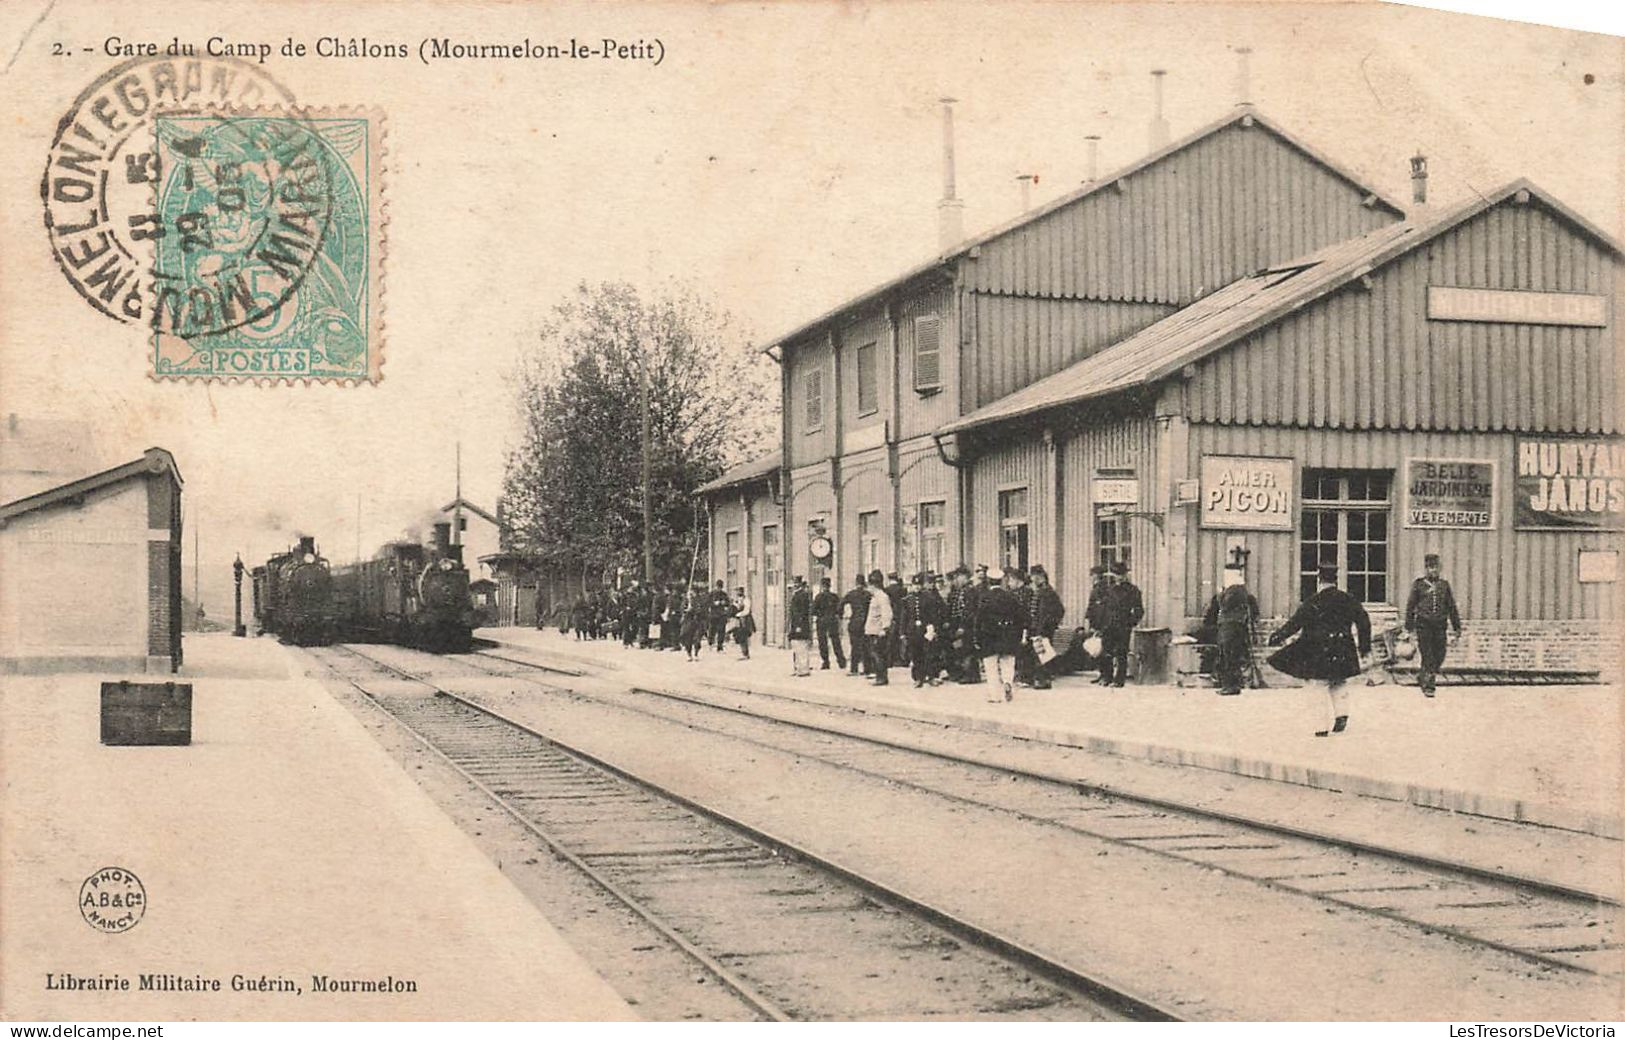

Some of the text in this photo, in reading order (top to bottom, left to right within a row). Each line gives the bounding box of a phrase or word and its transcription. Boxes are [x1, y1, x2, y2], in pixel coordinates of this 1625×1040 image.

[214, 350, 307, 372] POSTES
[1218, 467, 1277, 489] AMER
[1425, 463, 1478, 481] BELLE
[1207, 487, 1288, 515] PICON
